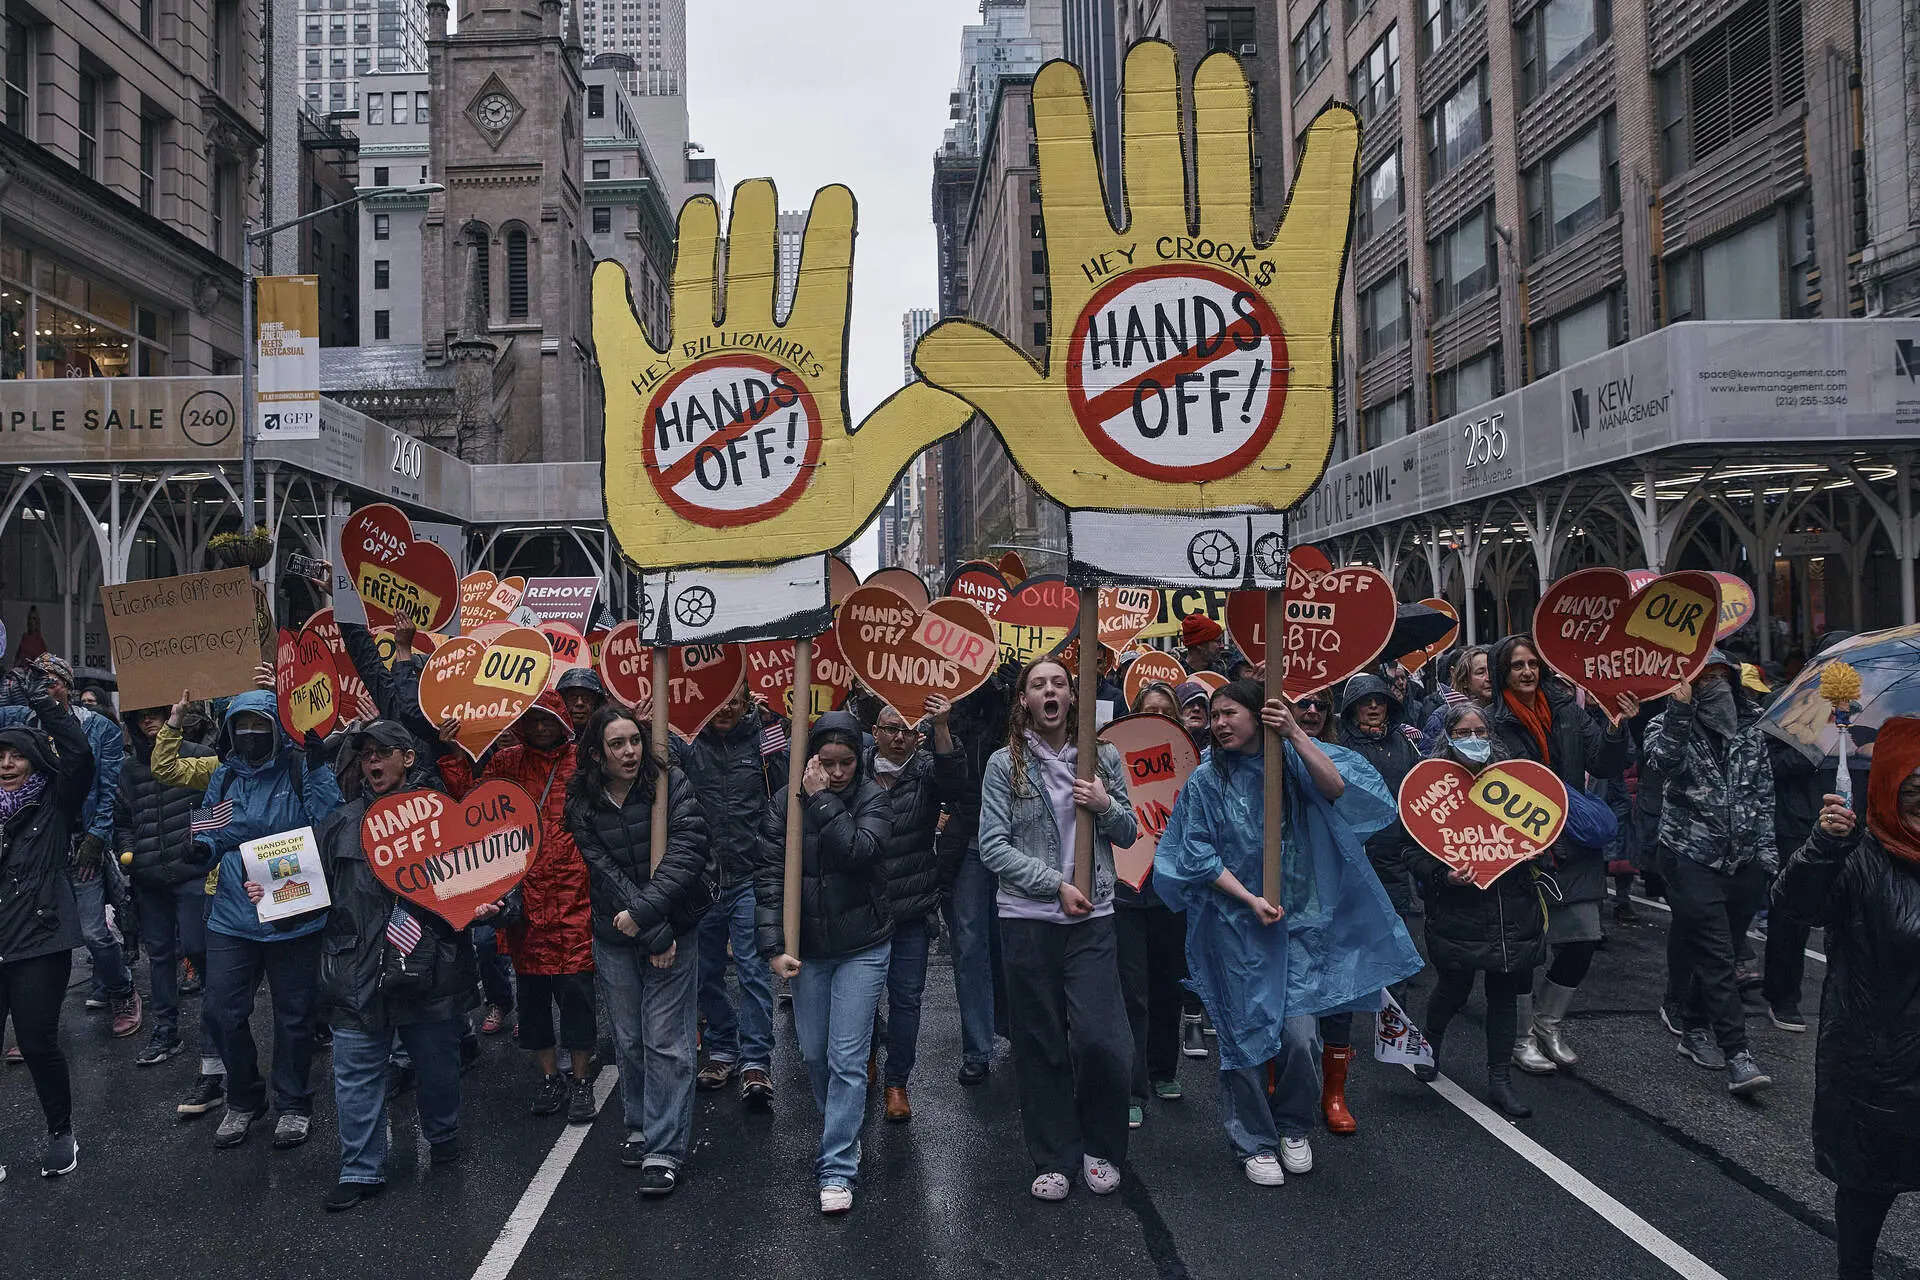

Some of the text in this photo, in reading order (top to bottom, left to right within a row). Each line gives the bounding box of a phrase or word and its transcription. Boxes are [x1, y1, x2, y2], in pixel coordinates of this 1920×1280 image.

[1081, 236, 1277, 290] HEY CROOK$
[260, 322, 285, 331] WHERE
[1088, 291, 1263, 370] HANDS
[261, 340, 283, 348] MEETS
[631, 331, 825, 396] HEY BILLIONAIRES
[1699, 369, 1848, 379] space@kewmanagement.com
[1132, 359, 1264, 438] OFF!
[1598, 375, 1634, 413] KEW
[1711, 383, 1848, 393] www.kewmanagement.com
[1775, 395, 1848, 407] (212) 255-3346
[83, 409, 163, 430] SALE
[188, 409, 228, 427] 260
[284, 413, 313, 424] GFP
[654, 368, 800, 451] HANDS
[1599, 396, 1669, 431] MANAGEMENT
[694, 412, 799, 491] OFF!
[1463, 412, 1508, 470] 255
[390, 433, 422, 480] 260
[1461, 476, 1481, 491] Fifth
[1482, 468, 1513, 486] Avenue
[360, 517, 407, 557] HANDS
[362, 537, 398, 564] OFF!
[109, 577, 249, 617] Hands Off our
[379, 572, 419, 600] OUR
[460, 581, 493, 593] HANDS
[463, 591, 487, 603] OFF!
[527, 587, 593, 598] REMOVE
[957, 579, 1008, 602] HANDS
[1322, 574, 1373, 594] OFF
[363, 576, 430, 626] FREEDOMS
[496, 589, 518, 608] OUR
[967, 598, 1001, 616] FF!
[1021, 587, 1080, 609] OUR
[1118, 589, 1149, 609] OUR
[1287, 603, 1332, 620] OUR
[1552, 595, 1621, 620] HANDS
[460, 605, 497, 620] PUBLIC
[536, 611, 584, 619] RRUPTION
[851, 604, 914, 627] HANDS
[1098, 613, 1149, 634] ACCINES
[1646, 593, 1703, 637] OUR
[1720, 602, 1747, 624] AID
[112, 618, 260, 665] Democracy!
[860, 624, 906, 646] OFF!
[923, 619, 984, 669] OUR
[1253, 624, 1341, 652] LBTQ
[1561, 618, 1611, 645] OFF!
[300, 640, 323, 665] OUR
[429, 642, 476, 671] HANDS
[685, 643, 723, 667] OUR
[749, 637, 820, 671] HANS
[1282, 651, 1328, 679] ghts
[1584, 646, 1690, 680] FREEDOMS
[436, 661, 470, 682] OFF!
[484, 652, 536, 686] OUR
[817, 658, 854, 691] OUR
[867, 651, 960, 689] UNIONS
[1136, 663, 1179, 680] HANDS
[292, 686, 307, 706] THE
[308, 677, 331, 715] ARTS
[637, 676, 705, 704] DTA
[1133, 752, 1175, 778] OUR
[1409, 773, 1460, 816] HANDS
[1431, 790, 1466, 824] OFF!
[367, 793, 444, 841] HANDS
[465, 794, 515, 827] OUR
[1482, 781, 1550, 836] OUR
[288, 836, 304, 844] OFF
[374, 820, 442, 867] OFF!
[1438, 824, 1514, 844] PUBLIC
[395, 824, 534, 893] CONSTITUTION
[1443, 841, 1536, 862] SCHOOLS
